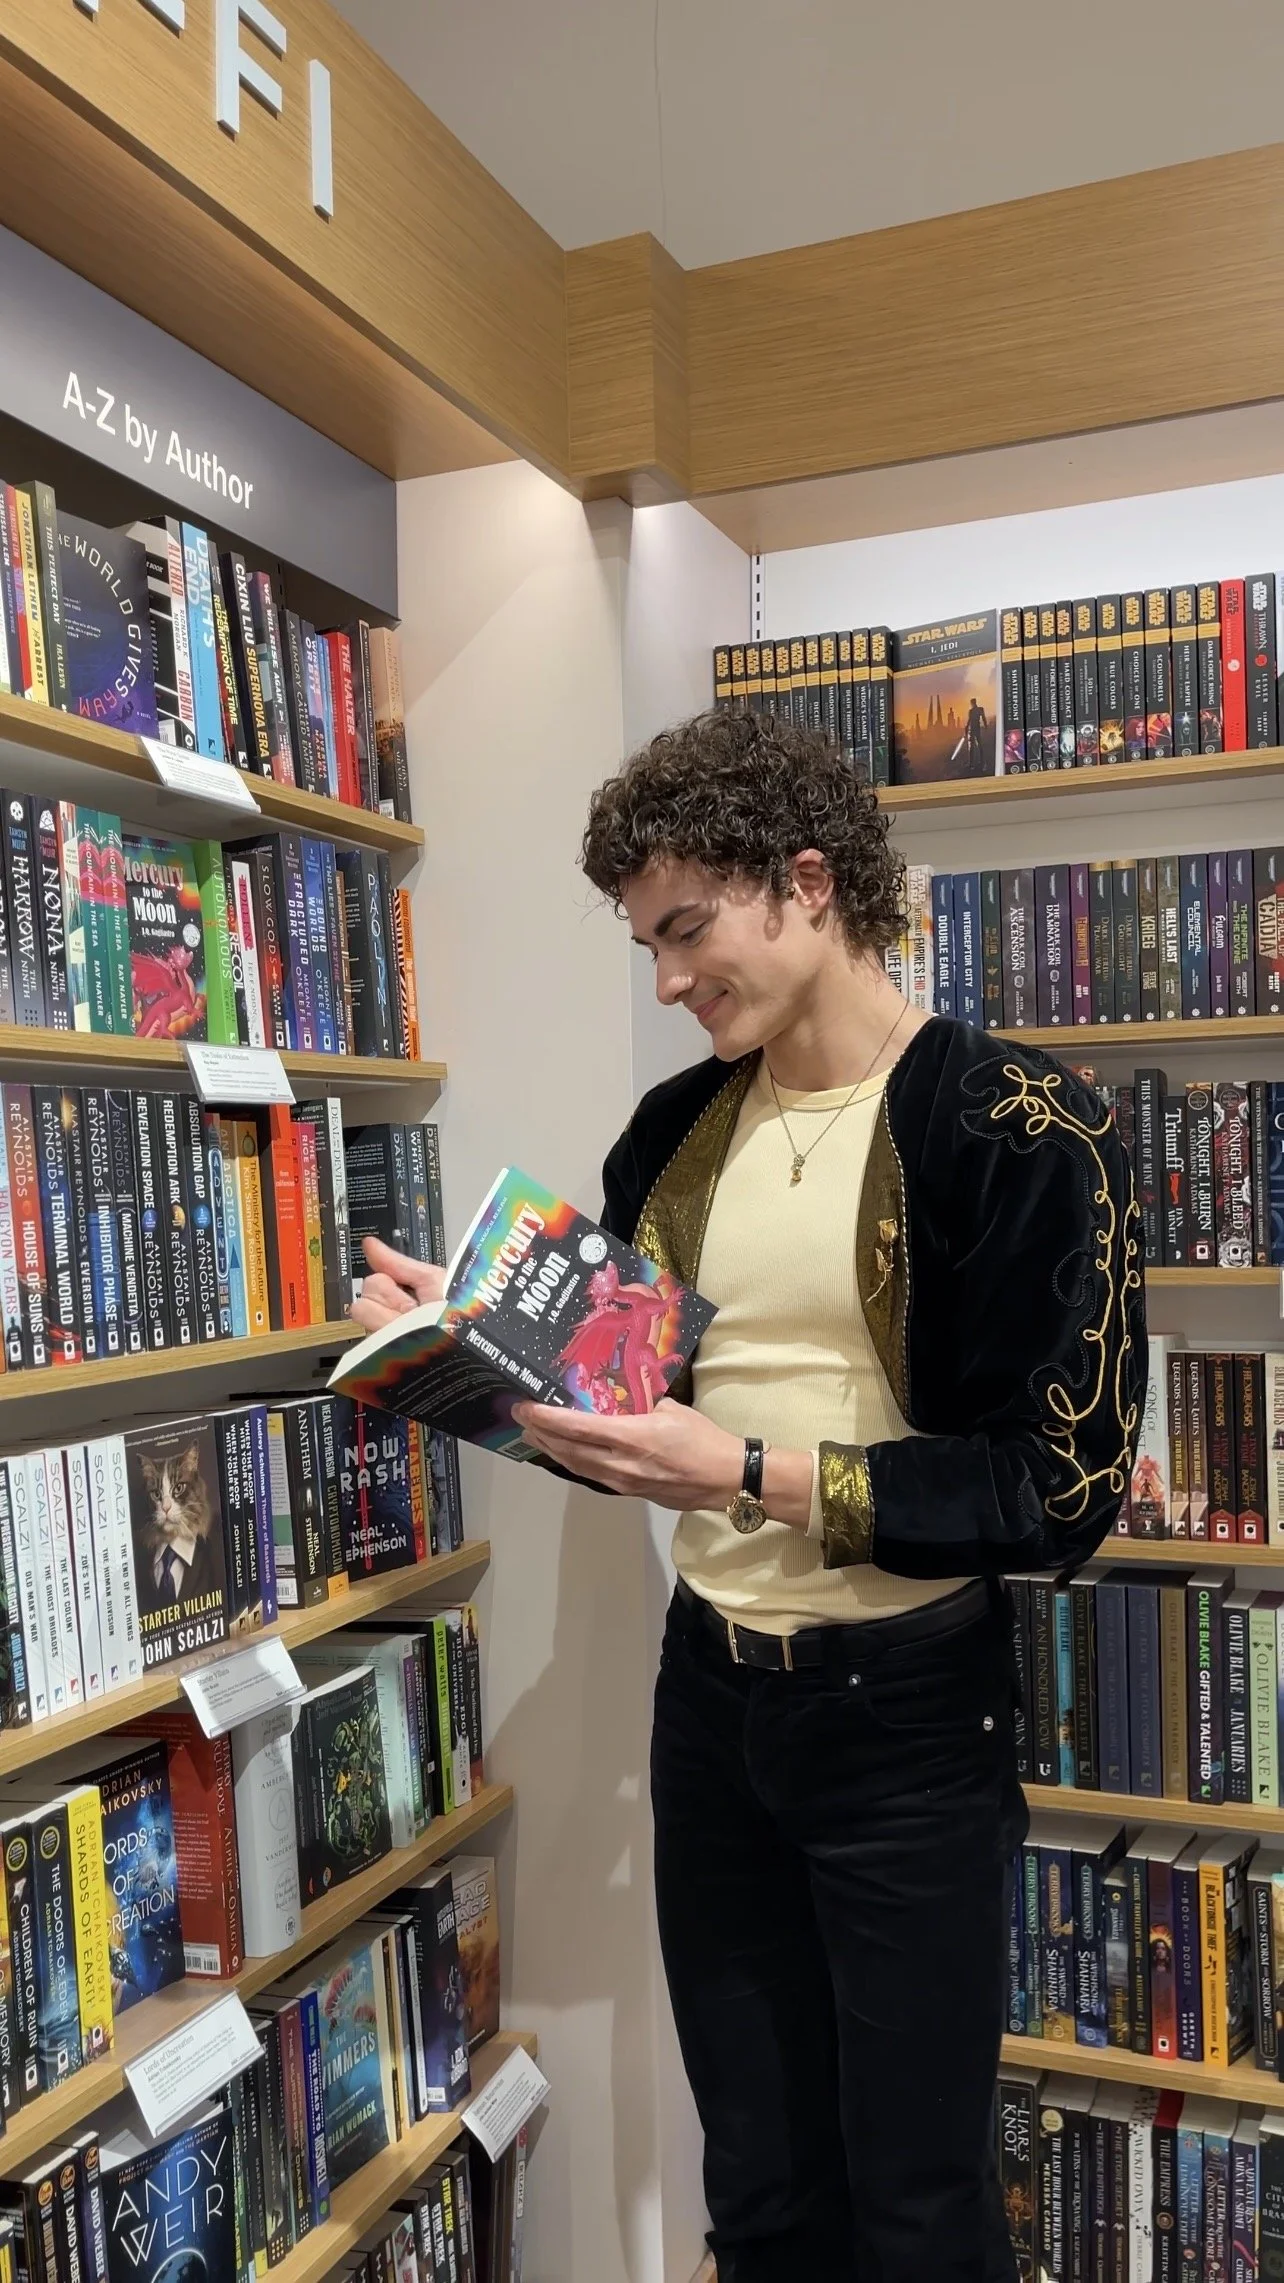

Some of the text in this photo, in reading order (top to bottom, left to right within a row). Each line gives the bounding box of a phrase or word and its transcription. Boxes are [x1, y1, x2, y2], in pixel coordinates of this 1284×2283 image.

[62, 371, 254, 509] A-Z by Author
[21, 502, 39, 622] JONATHAN LETHEM
[59, 535, 71, 548] HE
[75, 535, 134, 615] WORLD
[168, 542, 184, 598] ALTERED
[184, 545, 199, 605] END
[196, 536, 215, 649] DEATH'S
[235, 563, 255, 645] CIXIN LIU
[115, 623, 142, 698] GIVES
[902, 618, 988, 646] STAR WARS
[940, 641, 958, 652] JEDI
[1258, 612, 1266, 650] THRAWN
[79, 688, 118, 717] WAY
[178, 669, 193, 722] CARBON
[246, 647, 270, 759] SUPERNOVA ERA
[340, 643, 354, 736] THE HALTER
[1156, 653, 1164, 703] SCOUNDRELS
[132, 896, 178, 925] Moon
[212, 857, 232, 980] AUTONOMOUS
[261, 864, 277, 964] SLOW GODS
[288, 899, 300, 938] DARK
[294, 883, 309, 965] FRACTURED
[308, 896, 320, 952] WORLDS
[316, 907, 327, 953] BOUND
[1010, 906, 1020, 972] ASCENSION
[1046, 904, 1055, 967] DAMNATION
[1141, 915, 1155, 949] KRIEG
[1165, 907, 1177, 964] HELL'S LAST
[1187, 907, 1195, 951] COUNCIL
[1193, 900, 1202, 957] ELEMENTAL
[1259, 901, 1276, 955] CADIA
[912, 937, 925, 991] EMPIRE'S END
[938, 915, 949, 988] DOUBLE EAGLE
[963, 911, 973, 988] INTERCEPTOR CITY
[10, 1103, 28, 1198] REYNOLDS
[42, 1102, 59, 1190] REYNOLDS
[137, 1096, 155, 1210] REVELATION SPACE
[164, 1100, 181, 1204] REDEMPTION ARK
[188, 1101, 205, 1199] ABSOLUTION GAP
[1140, 1079, 1153, 1186] THIS MONSTER OF MINE
[1197, 1189, 1212, 1231] BURN
[1230, 1187, 1244, 1230] BLEED
[23, 1220, 44, 1333] HOUSE OF SUNS
[51, 1193, 75, 1325] TERMINAL WORLD
[97, 1205, 117, 1322] INHIBITOR PHASE
[121, 1213, 139, 1317] MACHINE VENDETTA
[196, 1229, 210, 1314] REYNOLDS
[339, 1245, 347, 1277] ROCHA
[472, 1201, 546, 1312] Mercury
[514, 1256, 538, 1290] to the
[517, 1250, 571, 1322] Moon
[80, 1261, 94, 1323] EVERSION
[466, 1327, 543, 1392] Mercury to the Moon
[259, 1451, 267, 1496] Schulman
[298, 1409, 312, 1479] ANATHEM
[340, 1460, 406, 1493] RASH
[344, 1435, 399, 1468] NOW
[14, 1471, 31, 1551] SCALZI
[72, 1459, 87, 1536] SCALZI
[327, 1485, 343, 1573] CRYPTONOMICON
[305, 1517, 316, 1575] STEPHENSON
[346, 1535, 407, 1562] EPHENSON
[351, 1526, 383, 1544] NEAL
[25, 1570, 39, 1644] OLD MAN'S WAR
[46, 1584, 58, 1658] GHOST BRIGADES
[62, 1576, 73, 1634] LAST COLONY
[138, 1589, 223, 1634] STARTER VILLAIN
[177, 1616, 225, 1652] SCALZI
[1199, 1590, 1211, 1669] OLIVIE BLAKE
[439, 1663, 447, 1697] watts
[1229, 1614, 1244, 1695] OLIVIE BLAKE
[1037, 1645, 1050, 1750] HONORED VOW
[1199, 1669, 1212, 1781] GIFTED & TALENTED
[1257, 1652, 1271, 1777] OLIVIE BLAKE
[1230, 1707, 1245, 1774] JANUARIES
[224, 1827, 232, 1877] ALPHA
[75, 1825, 96, 2008] SHARDS OF EARTH
[87, 1820, 107, 2005] ADRIAN TCHAIKOVSKY
[228, 1895, 236, 1951] OMEGA
[20, 1903, 38, 2049] CHILDREN OF RUIN
[53, 1896, 69, 2022] DOORS EDEN
[1046, 1948, 1059, 2011] SHANNARA
[1078, 1950, 1091, 2014] SHANNARA
[1258, 1891, 1272, 2019] SAINTS STORM SORROW
[1001, 2102, 1017, 2156] KNOT
[1017, 2109, 1030, 2162] LIAR'S
[112, 2135, 227, 2232] ANDY
[1043, 2162, 1051, 2251] MELISSA CARUSO
[1160, 2160, 1171, 2207] EMPRESS
[90, 2186, 104, 2278] DAVID WEBER
[120, 2183, 224, 2267] WEIR
